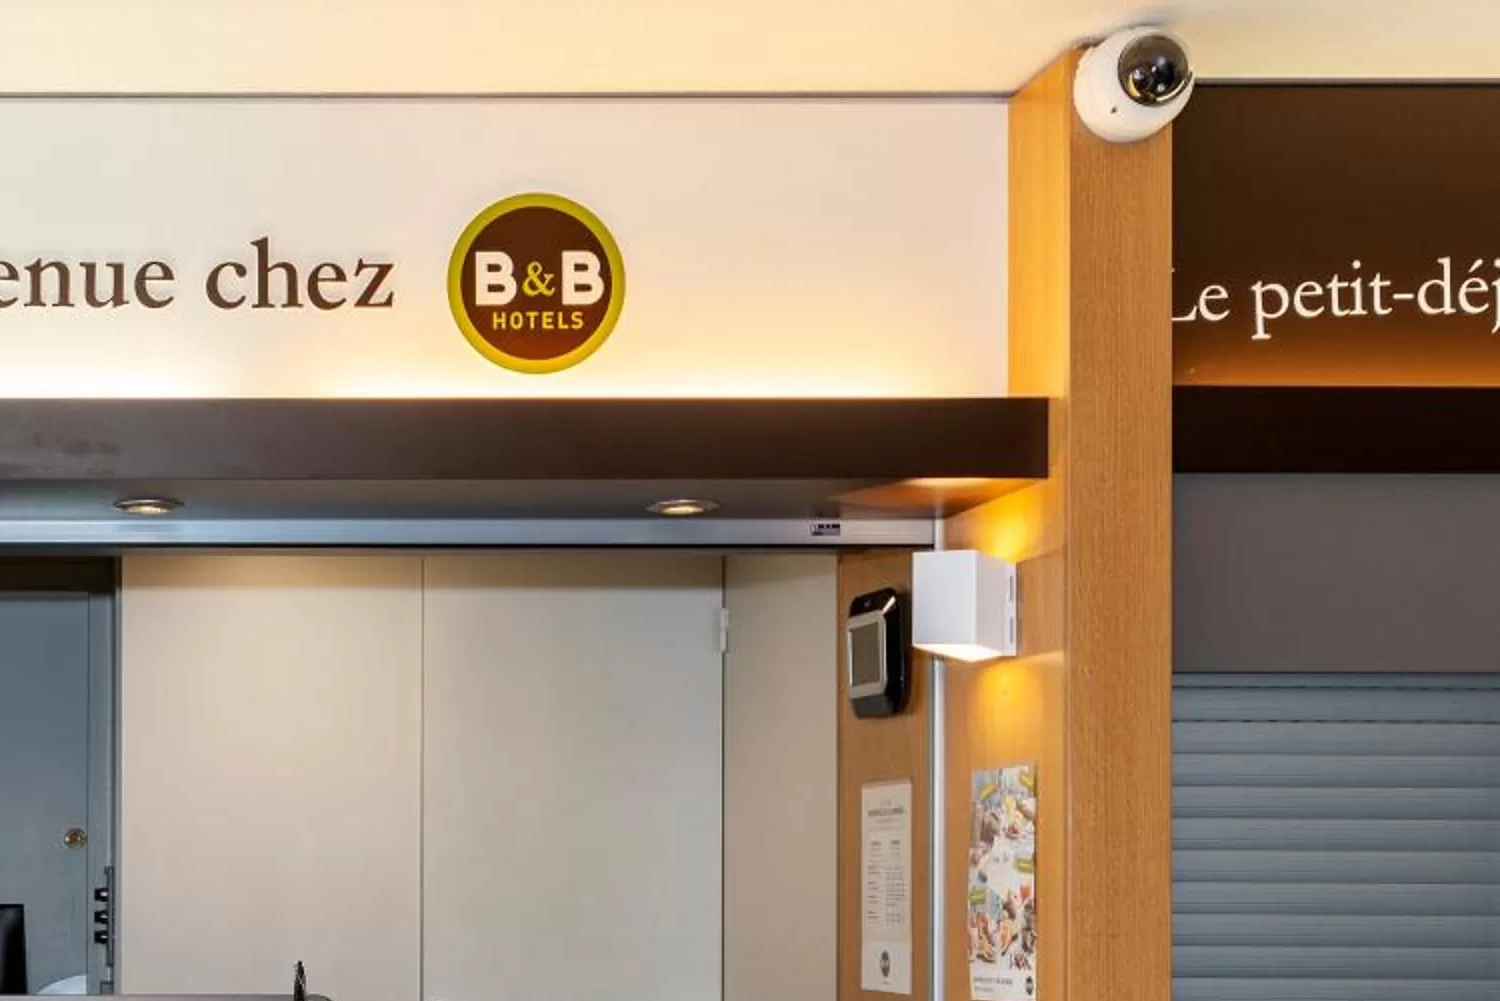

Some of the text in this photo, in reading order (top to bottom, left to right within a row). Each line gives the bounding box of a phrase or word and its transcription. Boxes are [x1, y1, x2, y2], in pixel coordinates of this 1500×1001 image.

[204, 236, 395, 310] chez
[475, 251, 605, 306] B&B
[492, 311, 585, 330] HOTELS
